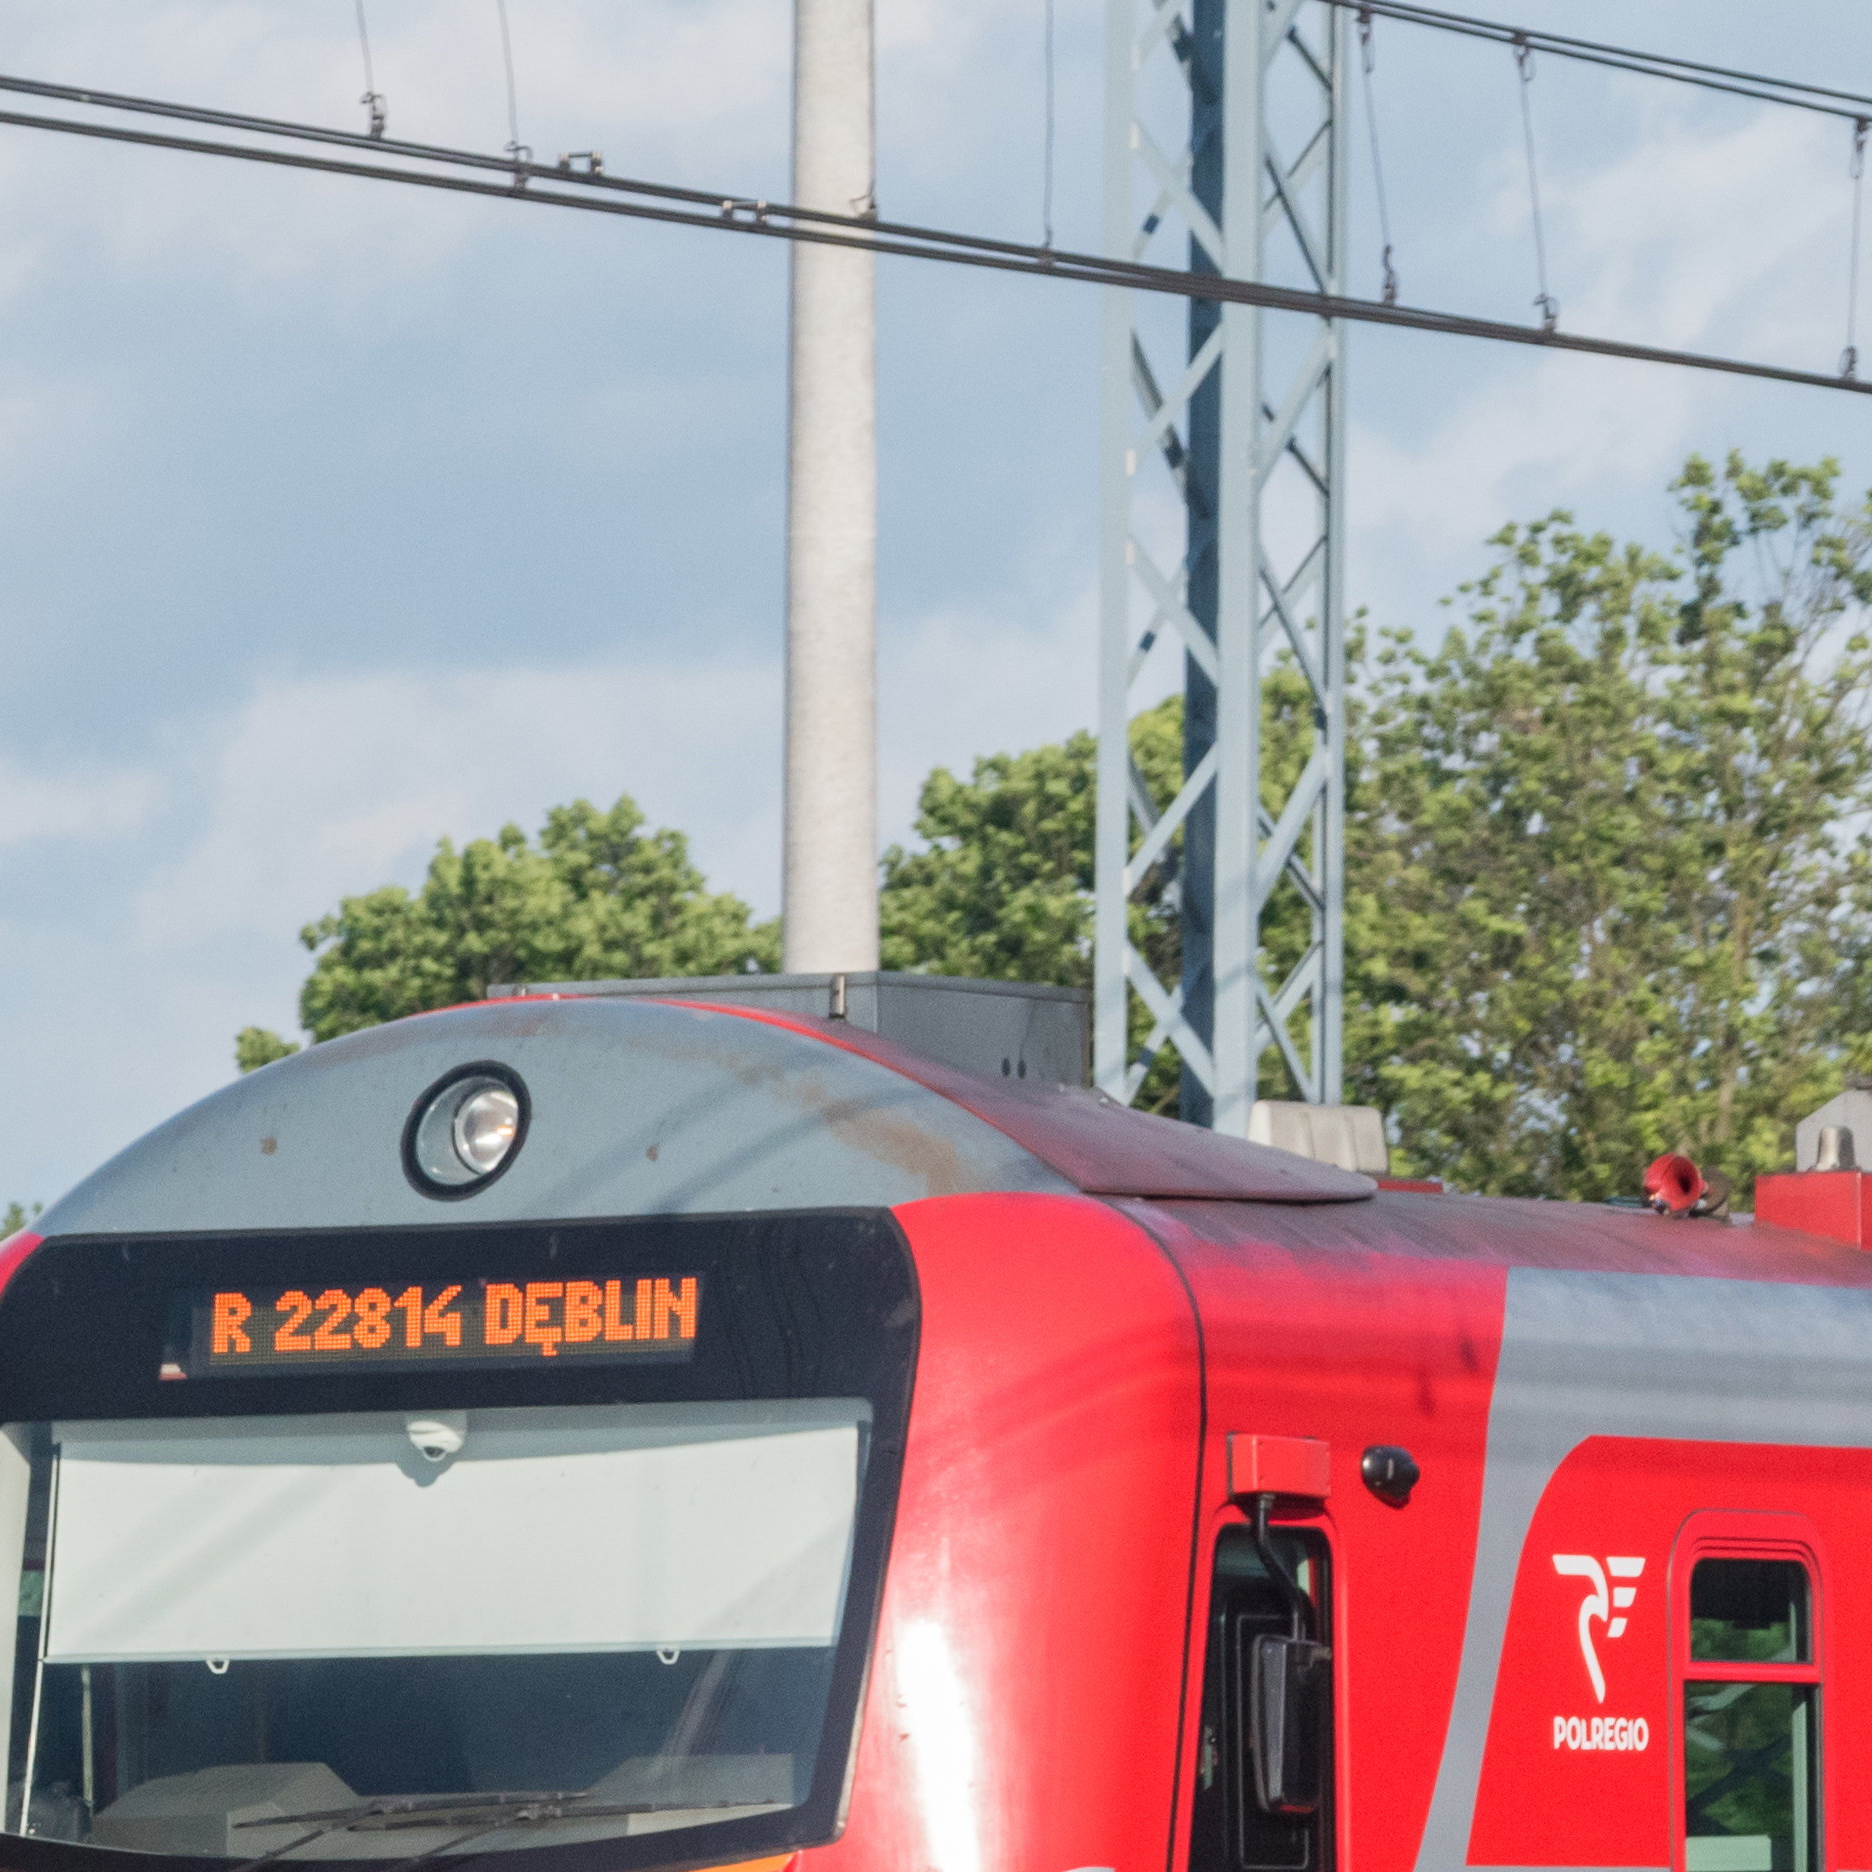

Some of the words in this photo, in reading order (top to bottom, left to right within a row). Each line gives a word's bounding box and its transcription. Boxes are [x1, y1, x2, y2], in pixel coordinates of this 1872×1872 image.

[213, 1292, 251, 1353] R
[274, 1285, 462, 1351] 22814
[484, 1277, 697, 1357] DĘBLIN
[1553, 1716, 1649, 1751] POLREGIO
